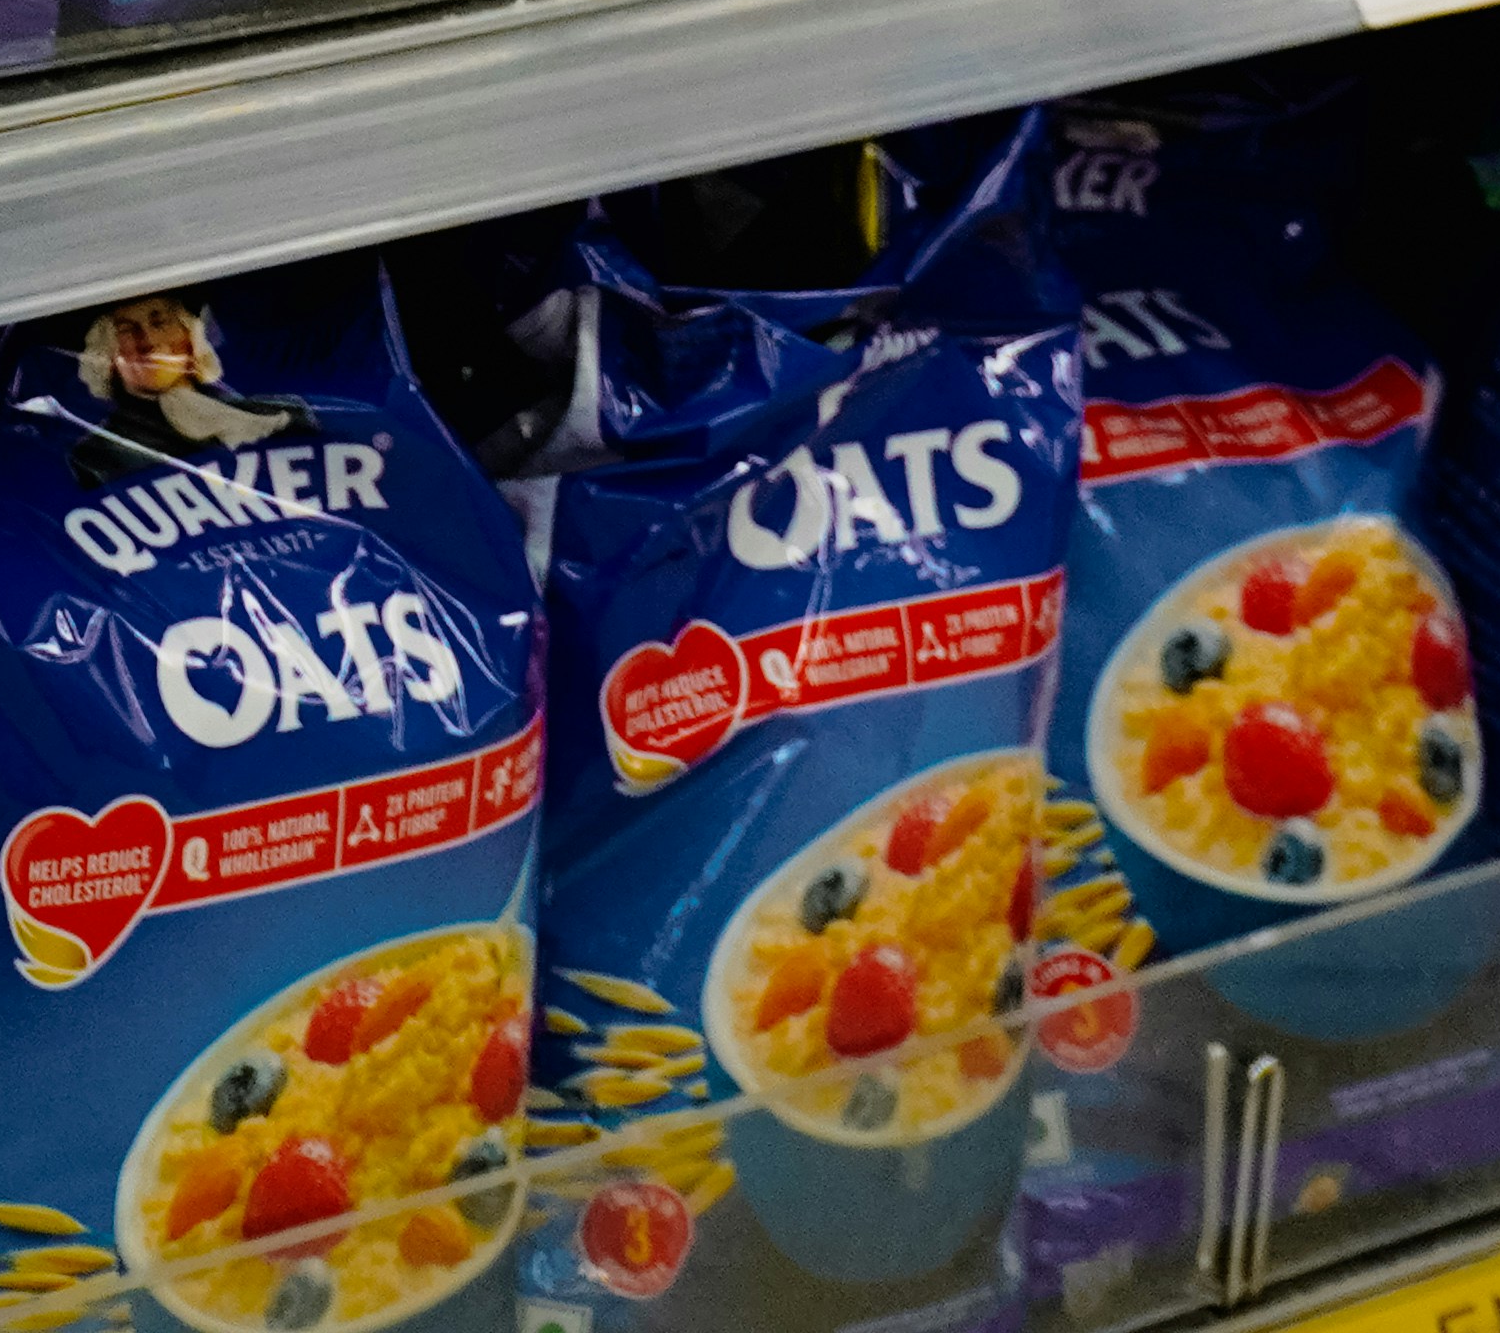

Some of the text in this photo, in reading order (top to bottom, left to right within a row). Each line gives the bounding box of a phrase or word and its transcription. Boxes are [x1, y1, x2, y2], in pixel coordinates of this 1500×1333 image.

[63, 441, 392, 577] QUAKER
[726, 419, 1023, 572] OATS
[155, 591, 462, 750] OATS
[28, 845, 153, 884] HELPS REDUCE
[28, 874, 151, 910] CHOLESTEROL
